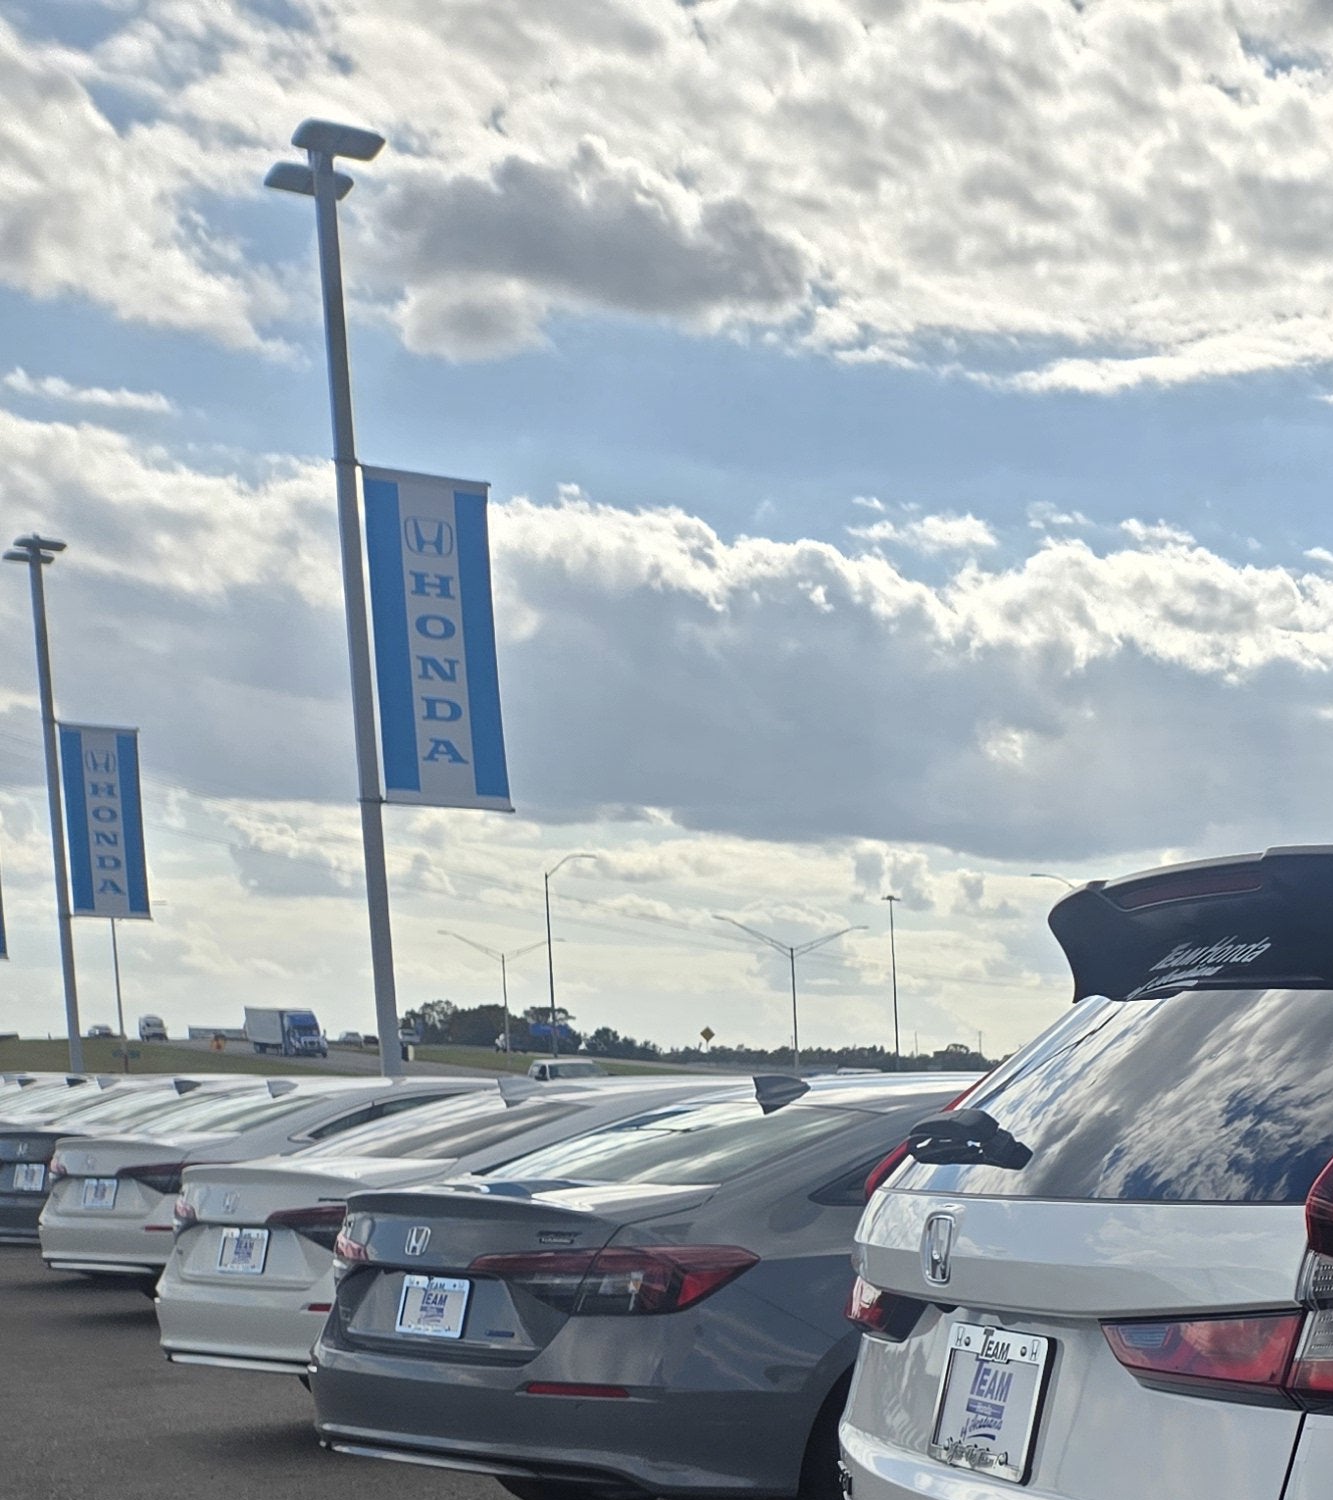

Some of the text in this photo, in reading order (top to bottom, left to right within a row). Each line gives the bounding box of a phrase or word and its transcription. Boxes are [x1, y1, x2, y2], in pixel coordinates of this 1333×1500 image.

[409, 570, 469, 765] HONDA
[88, 782, 127, 896] HONDA
[970, 1360, 1014, 1403] TEAM
[979, 1328, 1011, 1361] TEAM
